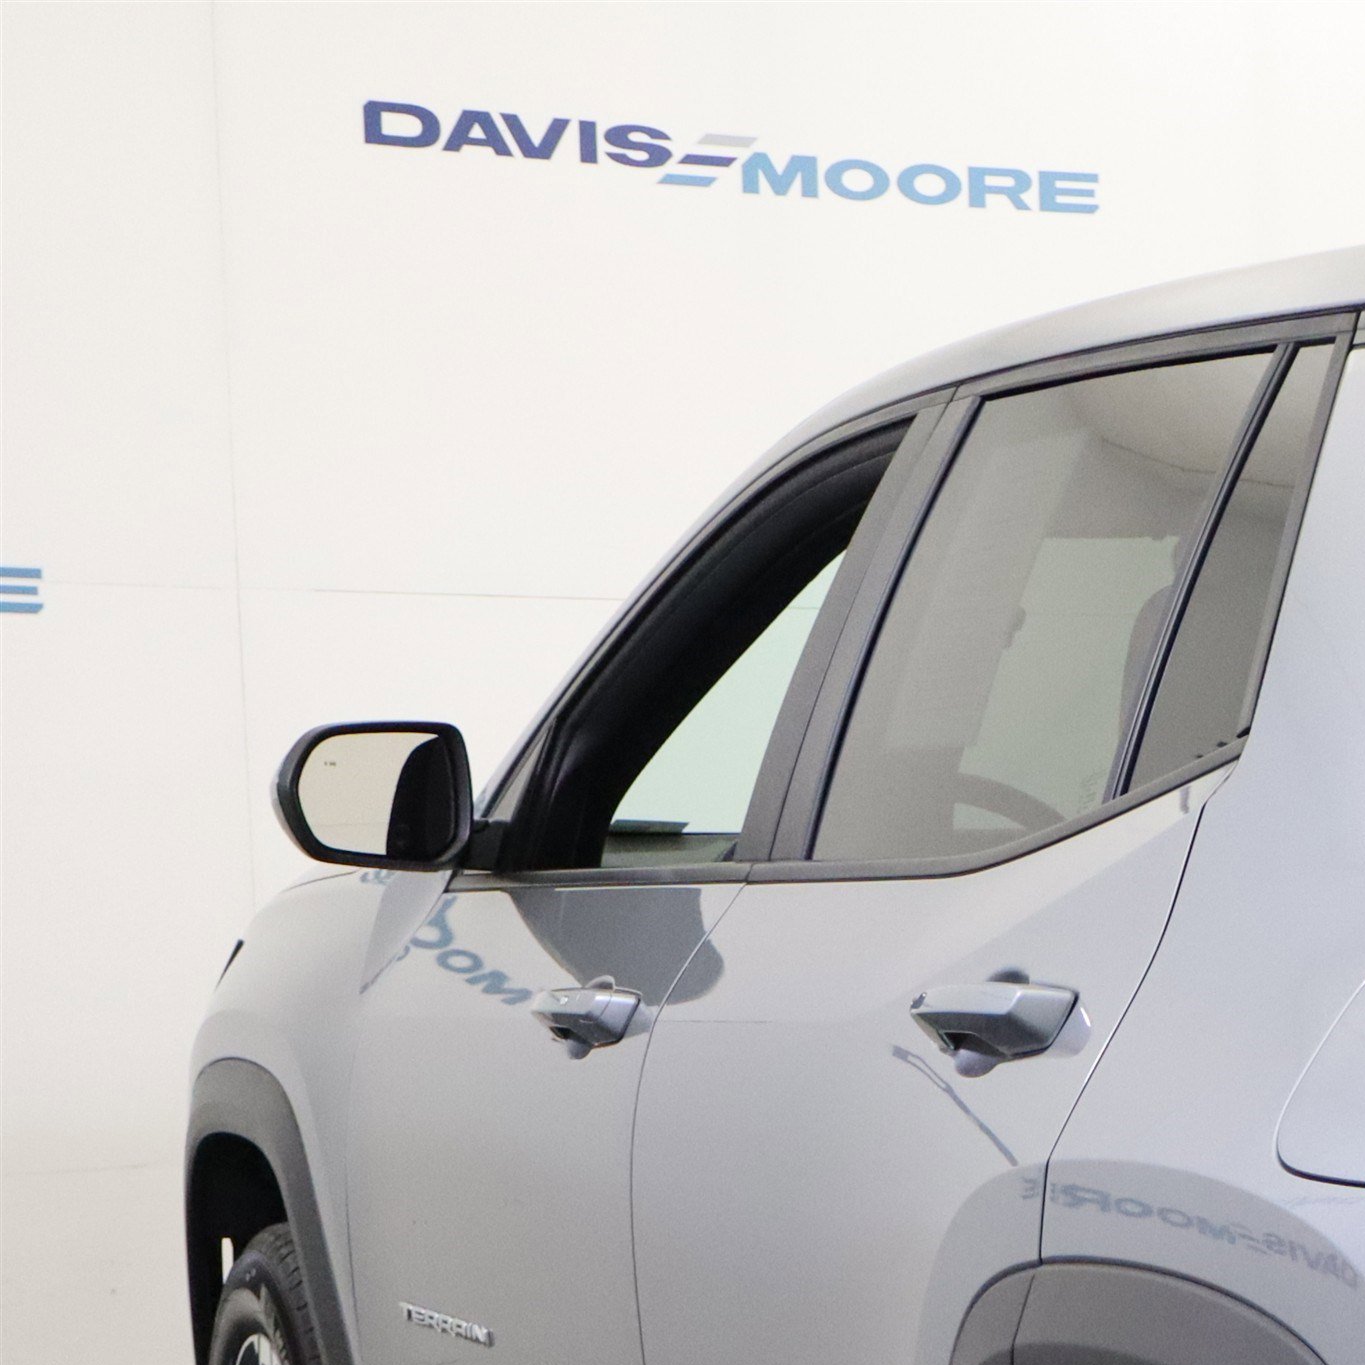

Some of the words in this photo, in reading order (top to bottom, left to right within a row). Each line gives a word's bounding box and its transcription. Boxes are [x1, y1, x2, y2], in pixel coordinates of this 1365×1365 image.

[363, 98, 672, 167] DAVIS
[741, 150, 1100, 214] MOORE
[399, 1301, 495, 1349] TERRAIN
